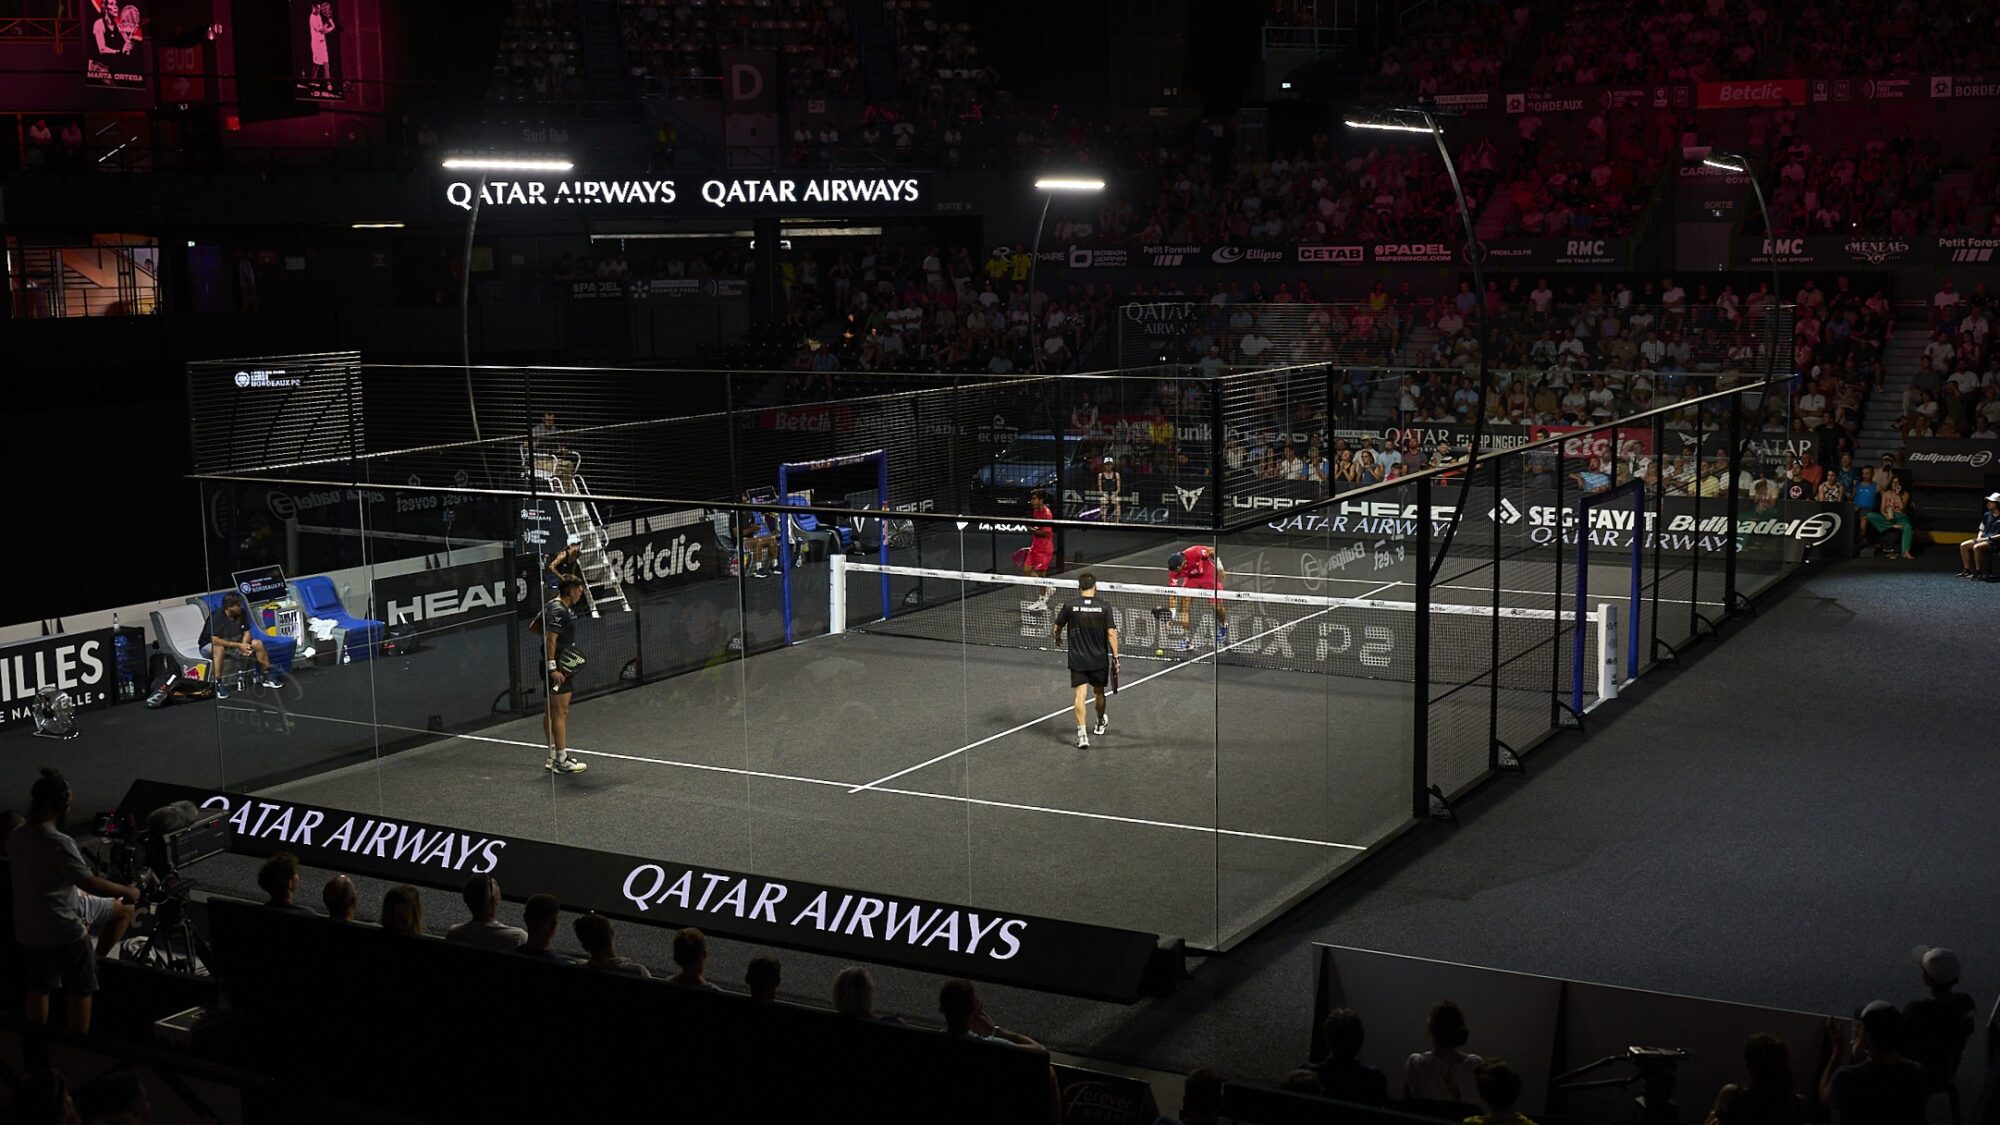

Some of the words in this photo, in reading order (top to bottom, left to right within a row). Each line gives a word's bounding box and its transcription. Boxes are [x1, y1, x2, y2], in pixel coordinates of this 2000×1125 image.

[165, 48, 194, 71] SUD
[87, 72, 112, 80] MARTA
[731, 64, 764, 100] D
[1719, 83, 1783, 101] Betclic
[447, 181, 547, 210] QATAR
[553, 180, 676, 203] AIRWAYS
[701, 179, 797, 207] QATAR
[802, 178, 919, 202] AIRWAYS
[1144, 245, 1162, 255] Petit
[1164, 245, 1202, 255] Forestier
[1566, 239, 1605, 256] RMC
[1762, 239, 1804, 255] RMC
[1939, 237, 1963, 248] Petit
[1246, 248, 1283, 262] Ellipse
[1300, 249, 1360, 260] CETAB
[1385, 428, 1449, 446] QATAR
[1908, 451, 1971, 465] Bullpadel
[1268, 515, 1348, 533] QATAR
[1668, 514, 1800, 538] Bullpadel
[606, 534, 701, 582] Betclic
[387, 578, 528, 626] HEAD
[321, 815, 509, 874] AIRWAYS
[622, 863, 788, 923] QATAR
[791, 890, 1029, 960] AIRWAYS
